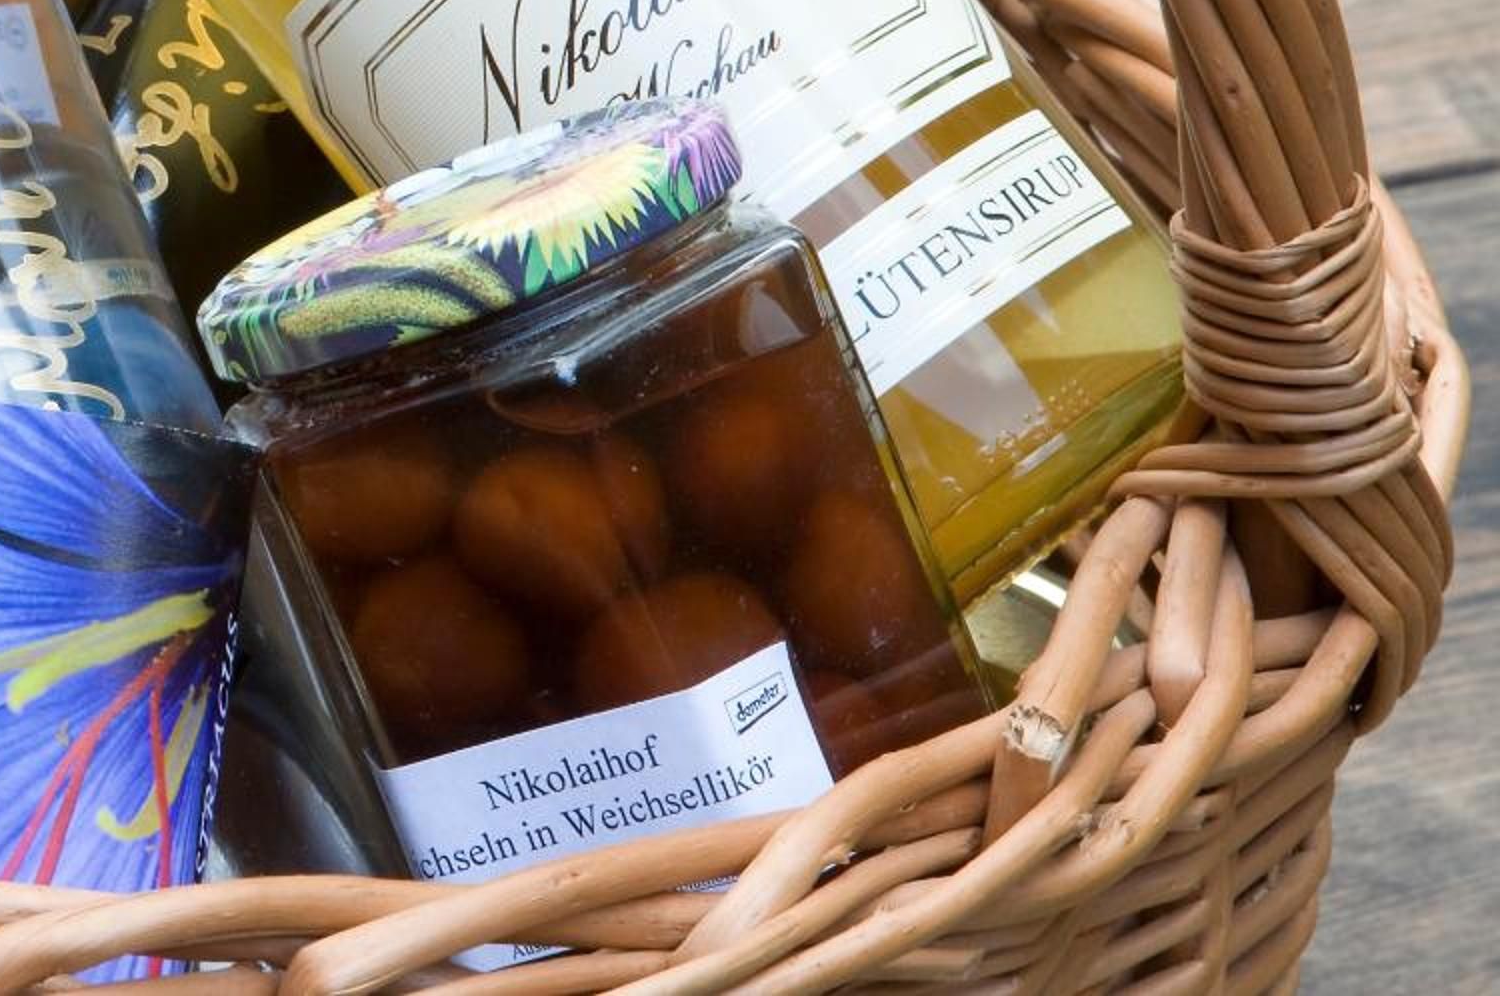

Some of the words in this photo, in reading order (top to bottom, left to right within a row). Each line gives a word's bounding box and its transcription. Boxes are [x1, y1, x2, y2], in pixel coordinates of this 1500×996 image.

[607, 23, 781, 102] Wchau
[736, 683, 779, 722] demeter
[478, 734, 661, 810] Nikolaihof
[413, 832, 518, 880] chseln
[521, 821, 558, 852] in
[561, 755, 778, 840] Weichsellikör
